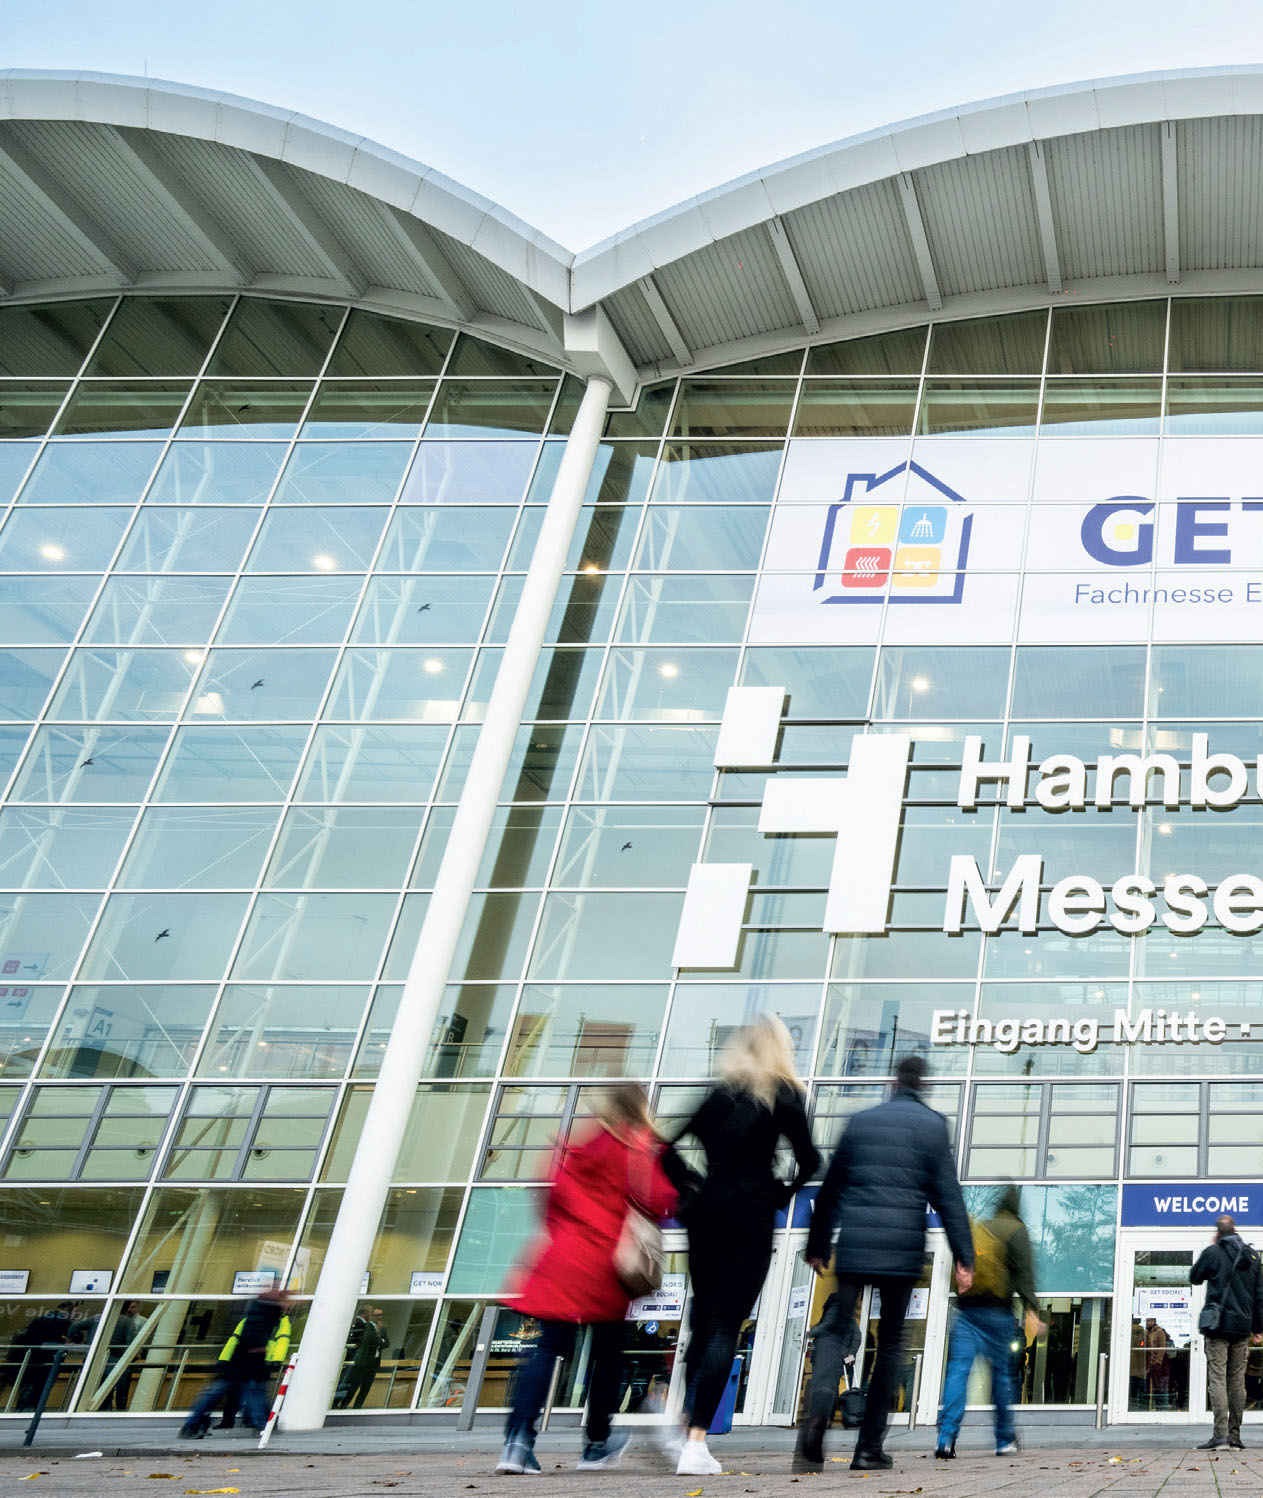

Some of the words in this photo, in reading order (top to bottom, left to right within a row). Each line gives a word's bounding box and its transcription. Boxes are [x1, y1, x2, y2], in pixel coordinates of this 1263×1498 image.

[1074, 582, 1234, 604] Fachmesse
[93, 1020, 112, 1037] A1
[931, 1008, 1099, 1053] Eingang
[1112, 1008, 1228, 1043] Mitte
[1154, 1196, 1249, 1213] WELCOME
